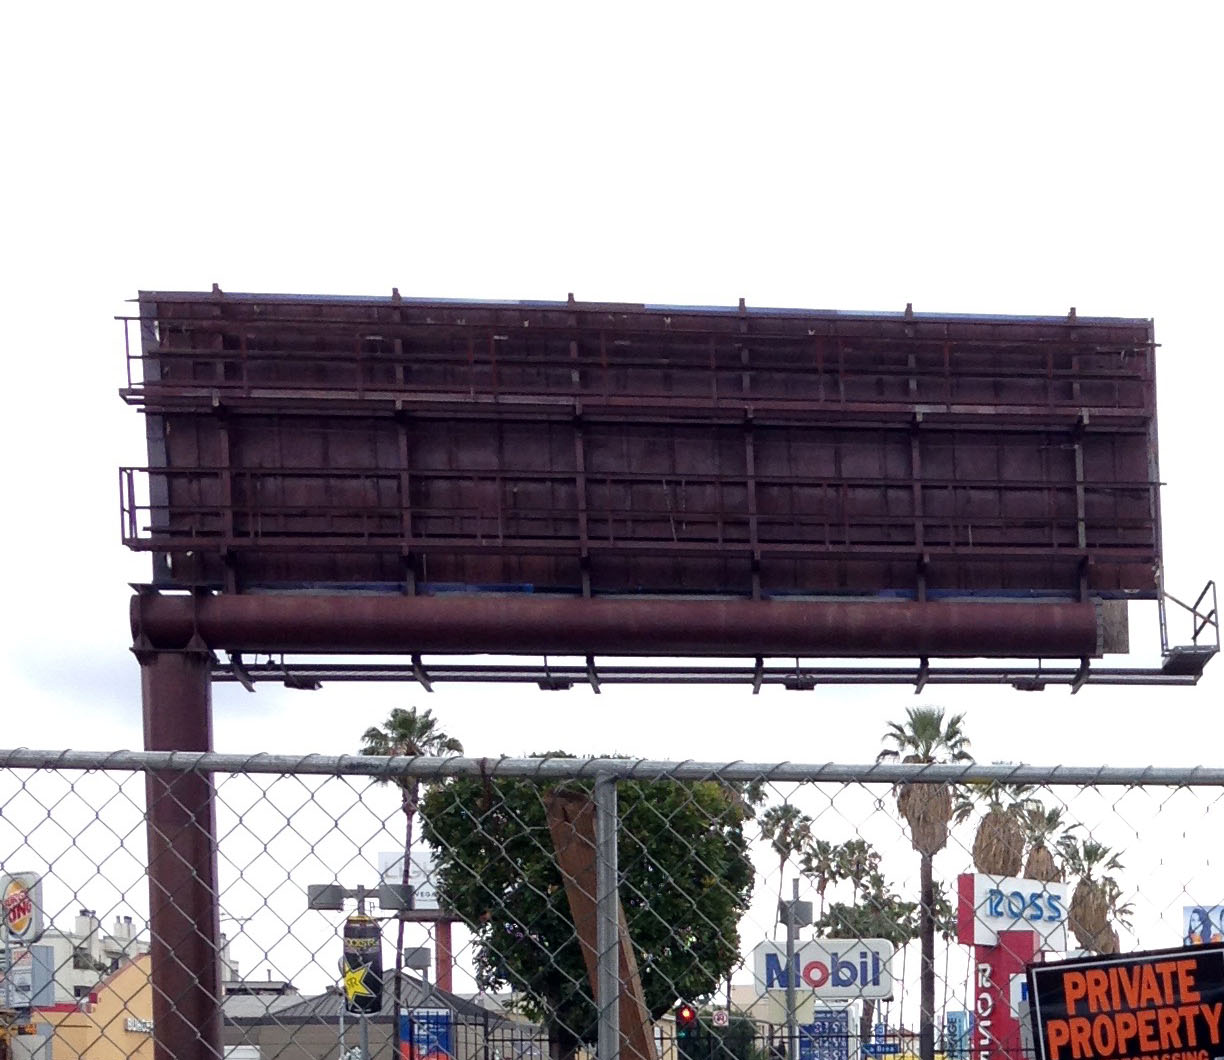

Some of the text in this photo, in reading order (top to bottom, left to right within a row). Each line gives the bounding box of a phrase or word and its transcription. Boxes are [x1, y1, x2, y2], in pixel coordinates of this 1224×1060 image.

[987, 888, 1062, 921] ROSS
[765, 952, 880, 988] Mobil
[1063, 959, 1201, 1015] PRIVATE
[1047, 1002, 1223, 1060] PROPERTY
